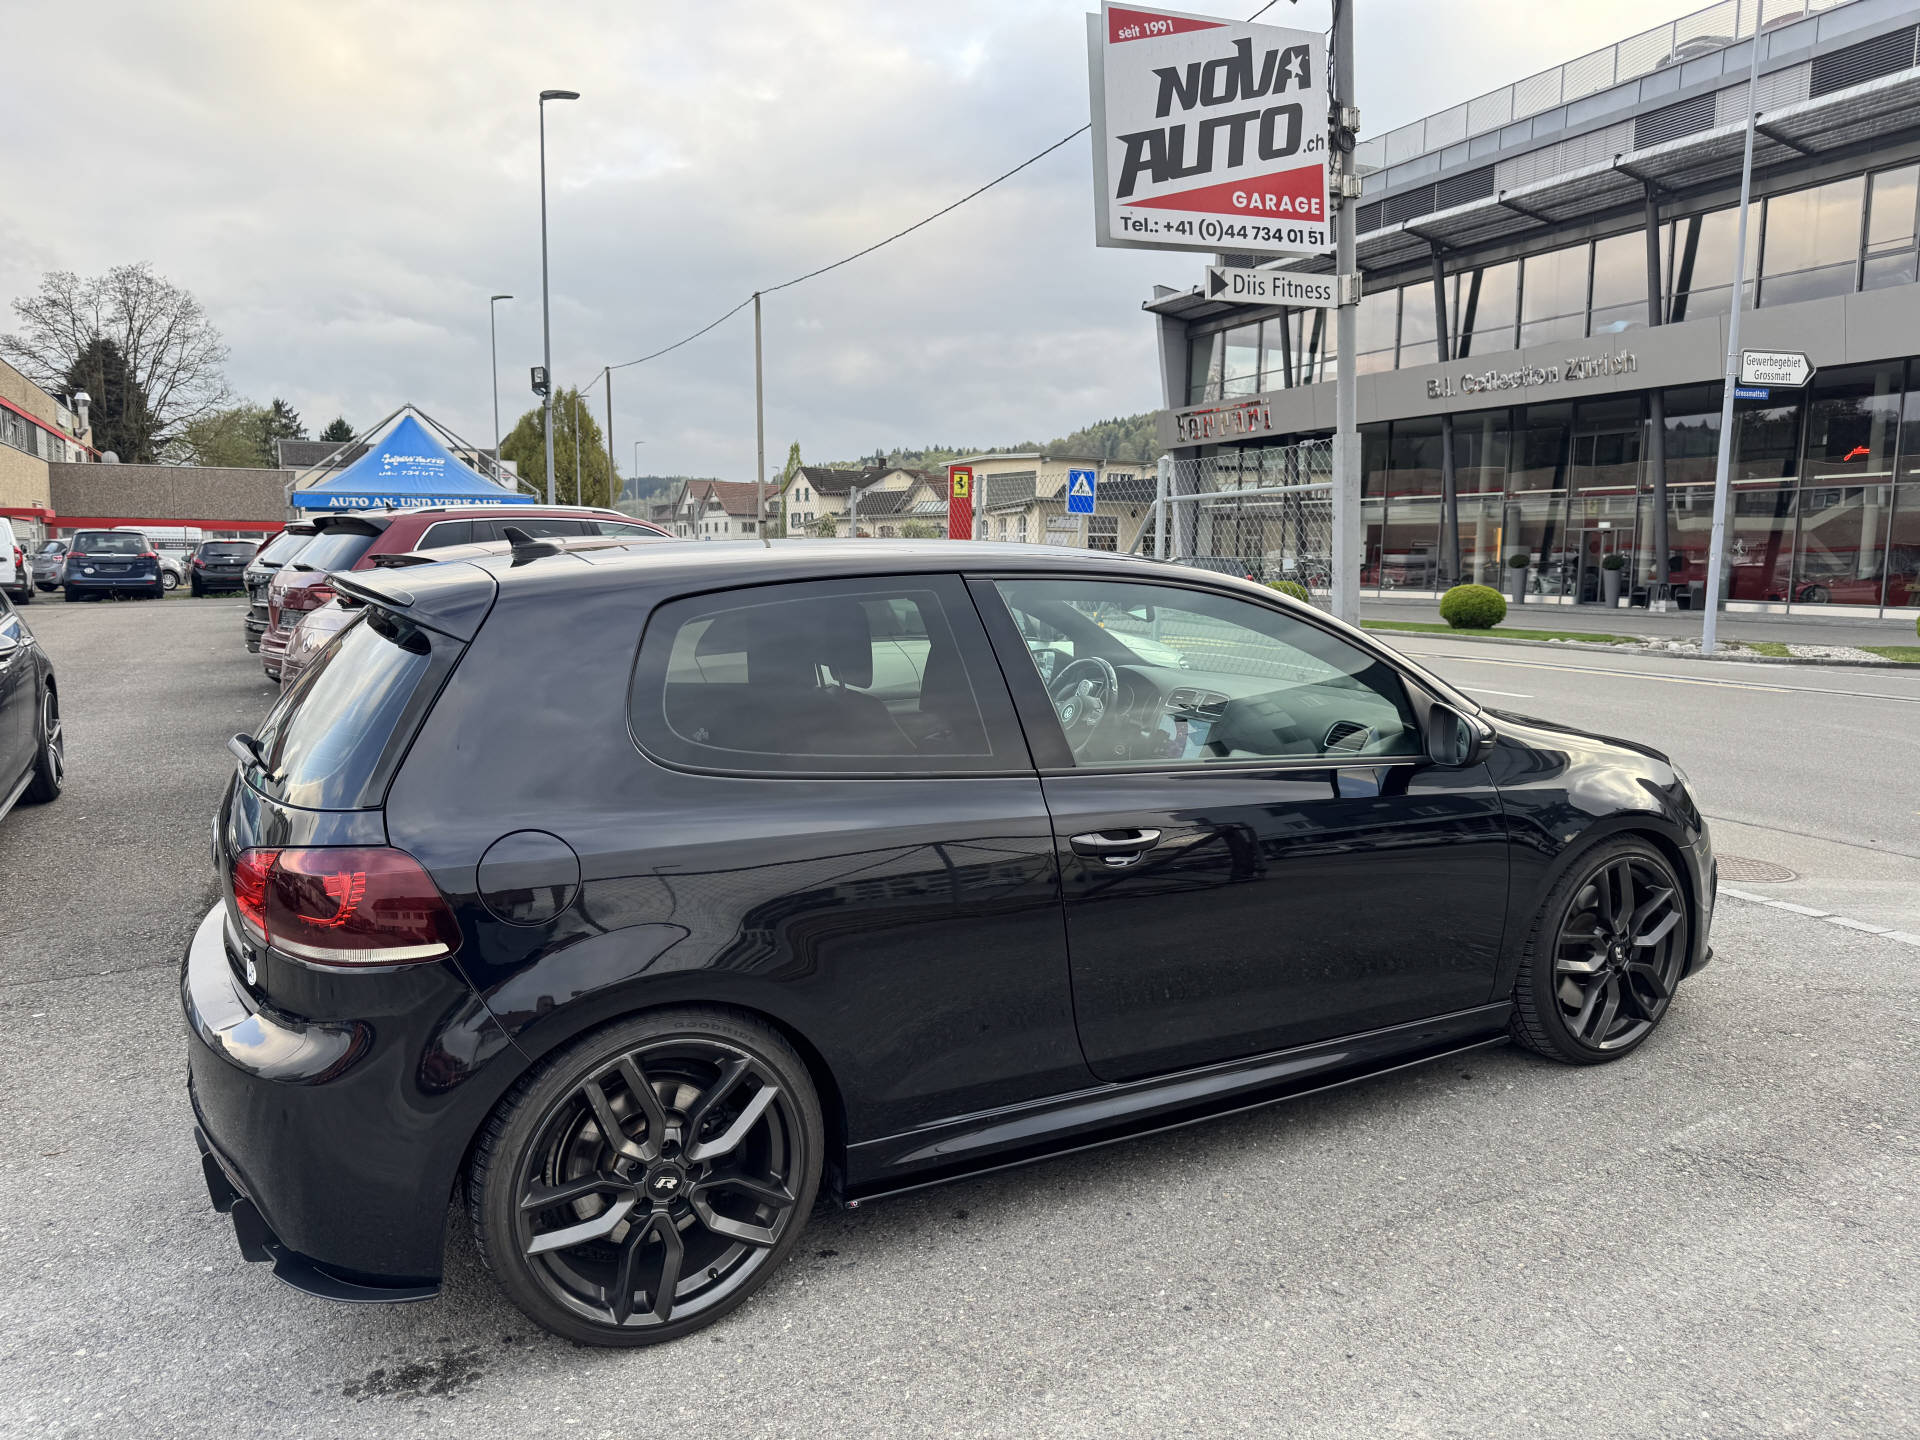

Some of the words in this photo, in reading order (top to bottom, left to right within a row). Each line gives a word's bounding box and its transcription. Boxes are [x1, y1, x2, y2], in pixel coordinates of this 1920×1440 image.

[1118, 26, 1140, 40] seit
[1144, 20, 1174, 36] 1991
[1151, 37, 1311, 118] NOVA
[1232, 191, 1321, 215] GARAGE
[1120, 216, 1159, 233] Tel.:
[1163, 220, 1193, 236] +41
[1199, 218, 1248, 242] (0)44
[1251, 226, 1283, 243] 734
[1287, 228, 1304, 244] 01
[1308, 230, 1325, 246] 51
[1233, 274, 1265, 295] Diis
[1273, 277, 1331, 300] Fitness
[1461, 365, 1559, 394] Collection
[1565, 349, 1638, 381] Zürich
[1746, 355, 1801, 369] Gewerbegebiet
[1754, 370, 1791, 382] Grossmatt
[1735, 389, 1768, 398] Grossmattstr.
[328, 496, 369, 507] AUTO
[400, 498, 433, 507] UND
